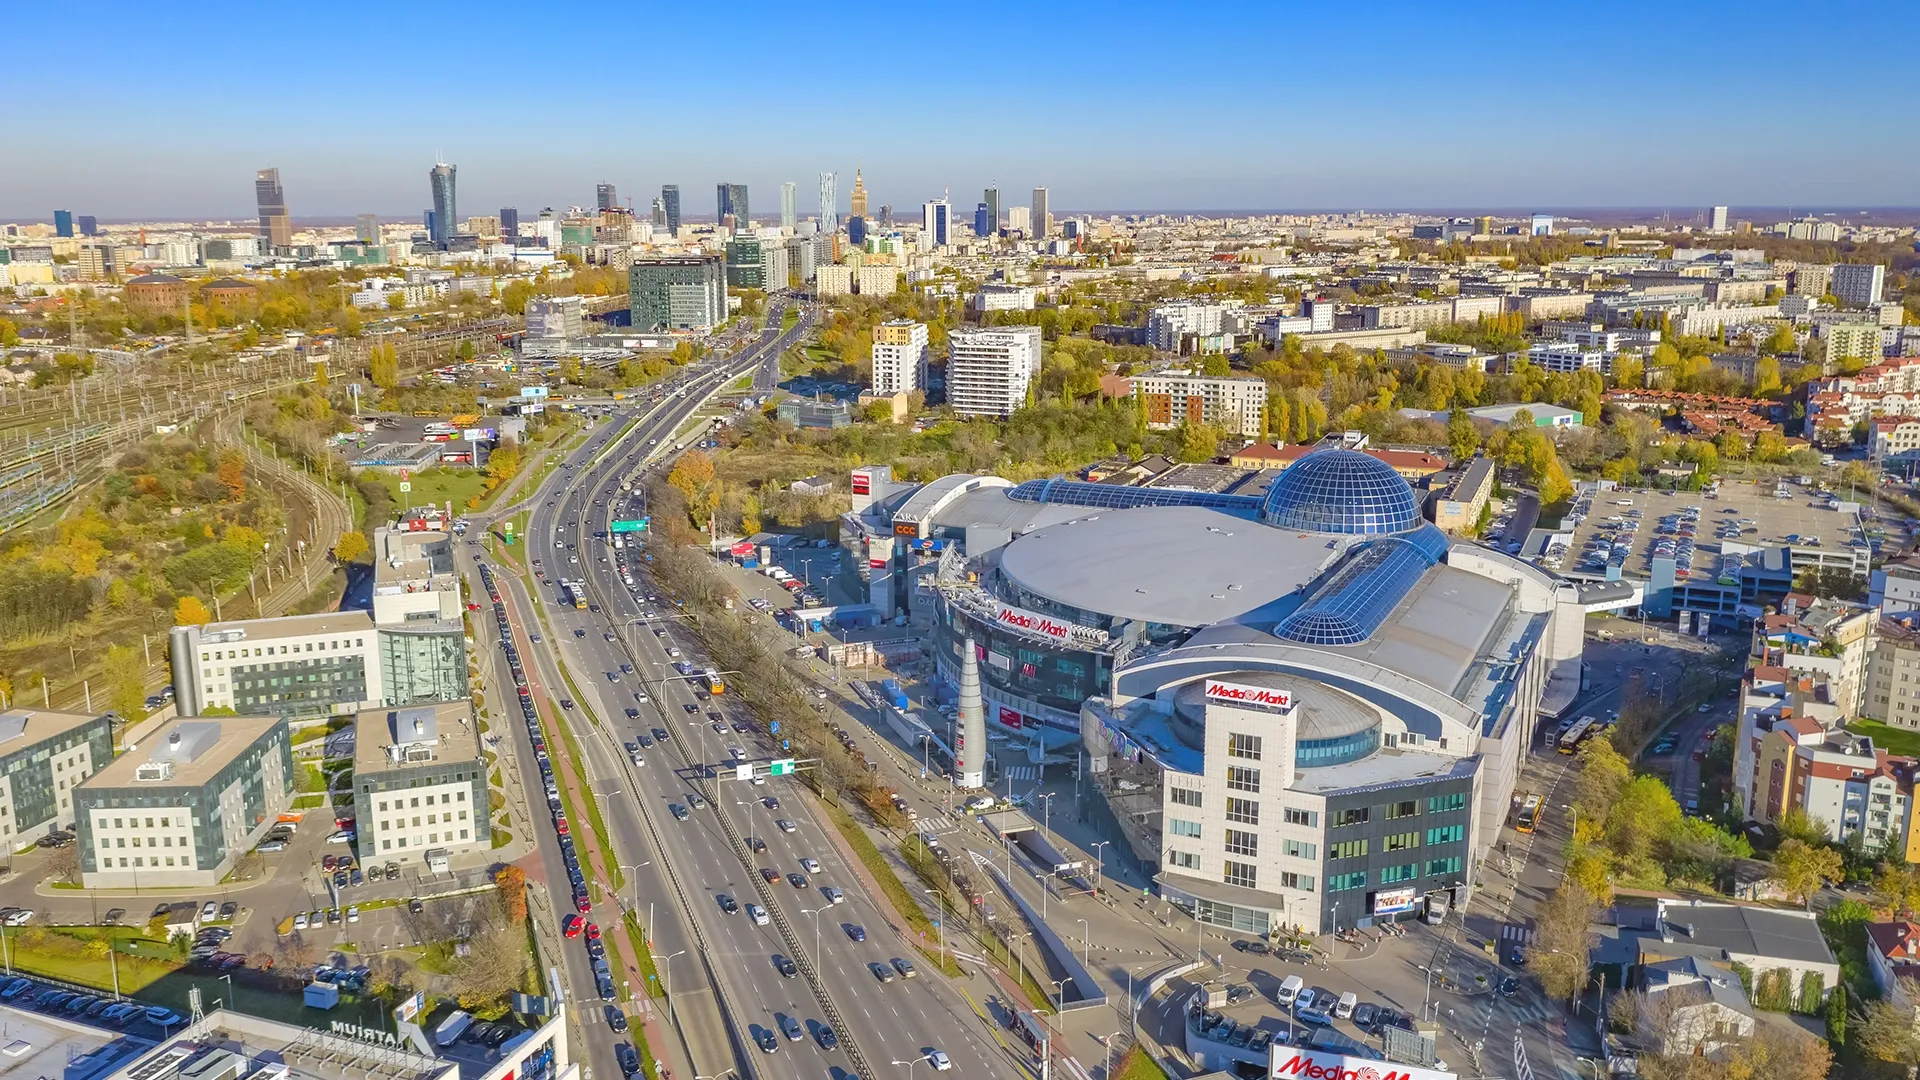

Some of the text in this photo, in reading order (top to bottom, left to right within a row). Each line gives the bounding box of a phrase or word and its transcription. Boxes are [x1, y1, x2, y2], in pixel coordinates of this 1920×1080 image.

[896, 525, 916, 534] CCC
[999, 608, 1068, 638] Media Markt
[1207, 684, 1288, 705] Media Markt
